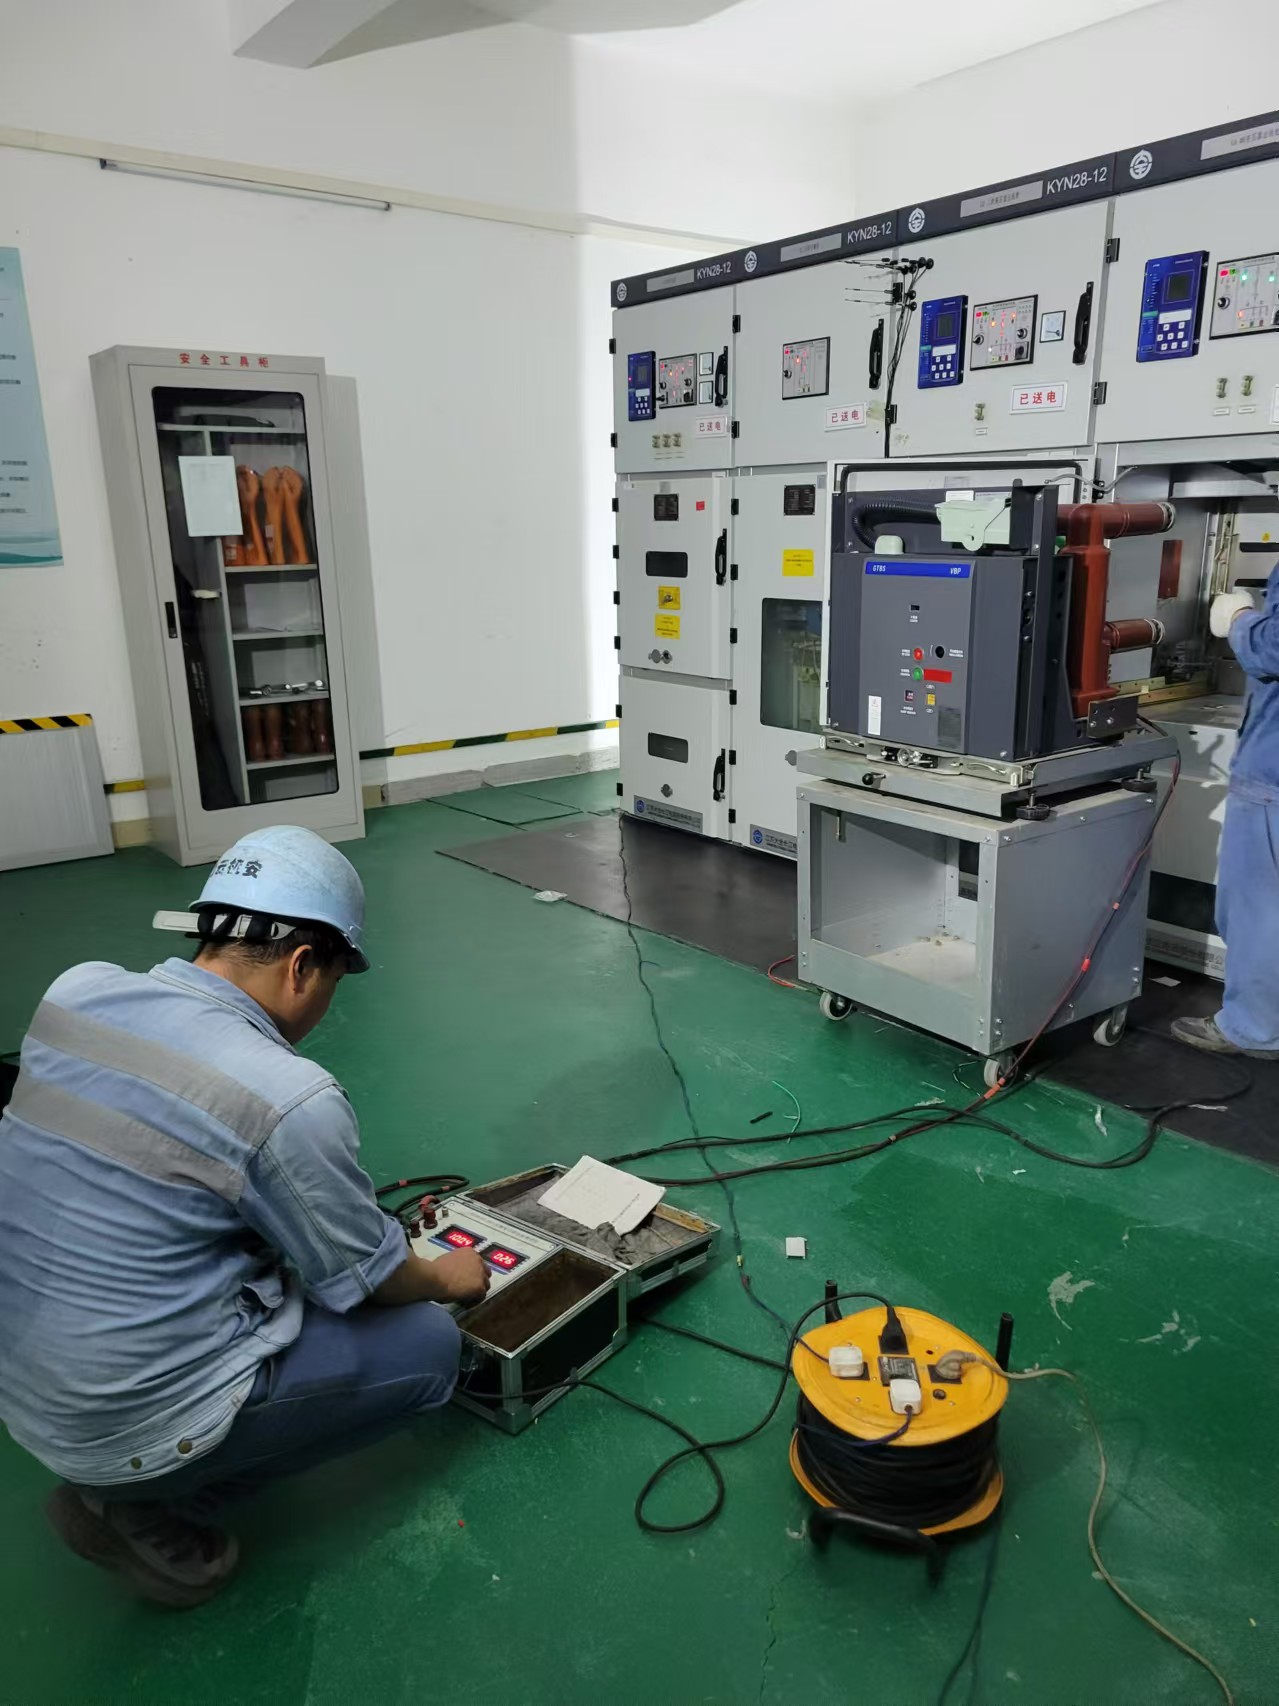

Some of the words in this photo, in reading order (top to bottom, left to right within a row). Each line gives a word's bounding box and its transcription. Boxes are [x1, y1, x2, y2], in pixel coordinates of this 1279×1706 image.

[1047, 167, 1107, 195] KYN28-12
[847, 221, 892, 244] KYN28-12
[697, 261, 731, 280] KYN28-12
[179, 353, 269, 368] 安全工具柜
[1020, 390, 1057, 405] 已送电
[832, 409, 859, 423] 已送电
[699, 421, 721, 432] 已送电
